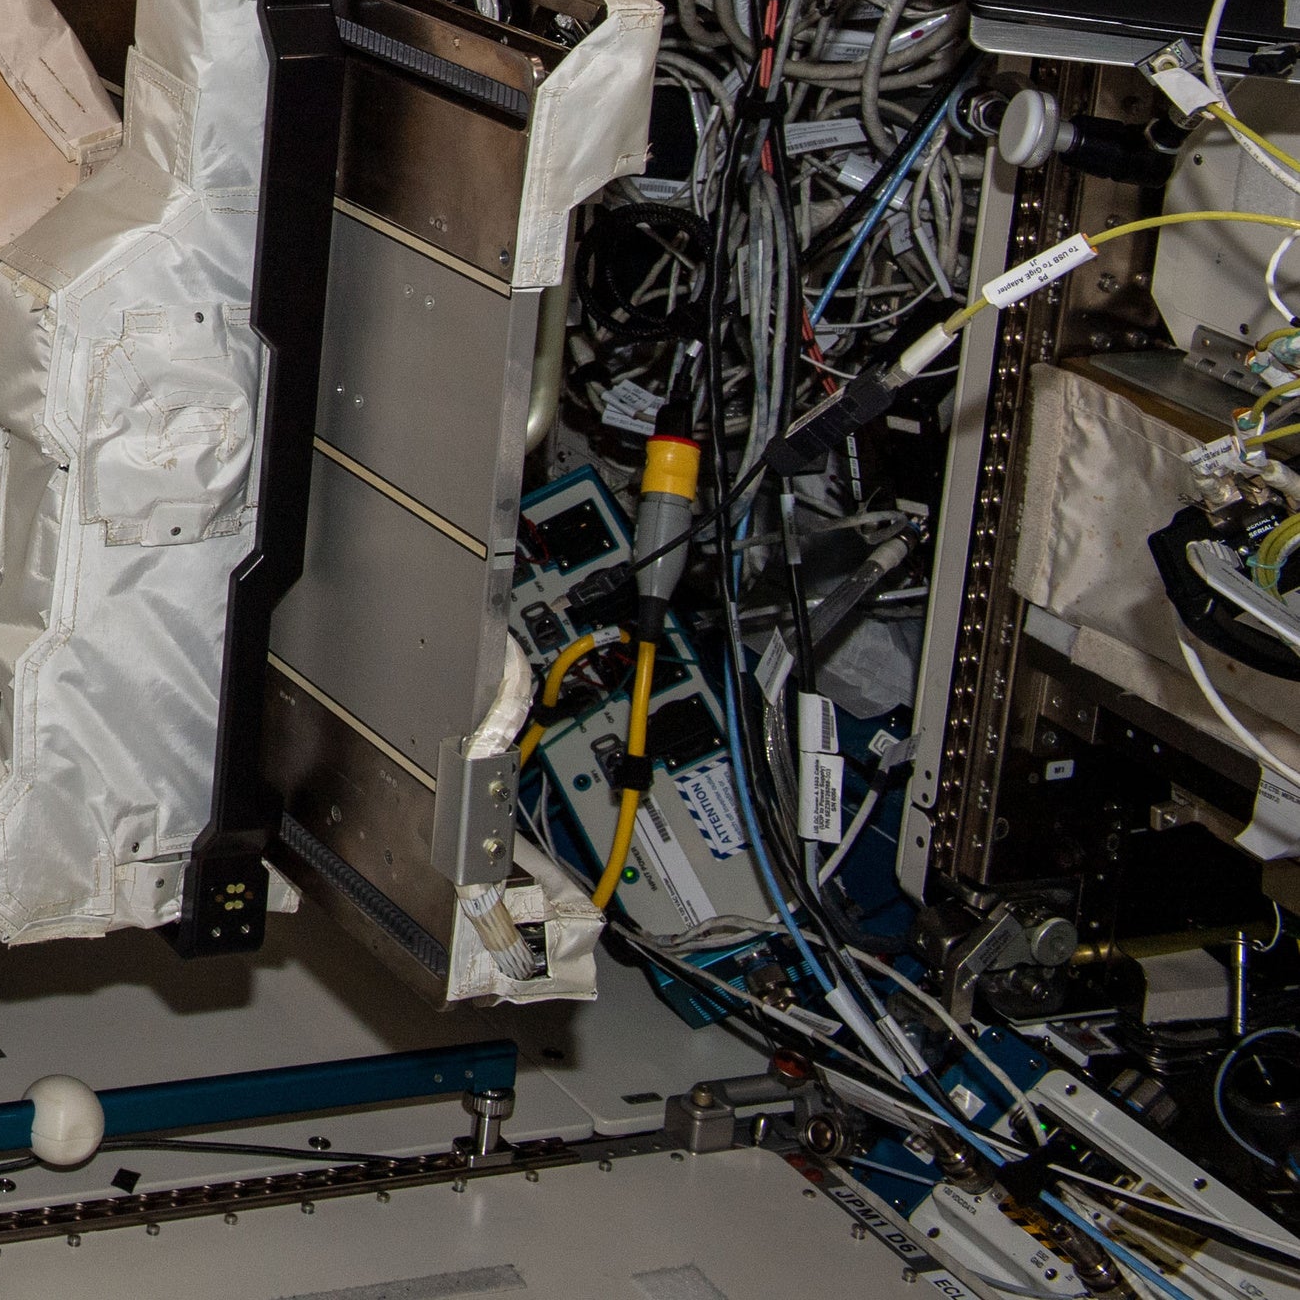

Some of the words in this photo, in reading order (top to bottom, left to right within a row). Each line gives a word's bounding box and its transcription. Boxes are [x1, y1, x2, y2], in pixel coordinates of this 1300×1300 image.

[1068, 244, 1079, 254] To
[1029, 258, 1038, 267] J1
[1042, 260, 1053, 270] To
[1052, 251, 1069, 266] USB
[1025, 266, 1043, 281] GigE
[1038, 273, 1049, 282] P5
[997, 274, 1026, 295] Adapter
[690, 781, 733, 848] ATTENTION
[631, 846, 645, 870] POWER
[643, 869, 657, 891] INPUT
[836, 1188, 885, 1232] JPM1
[883, 1226, 917, 1255] D6
